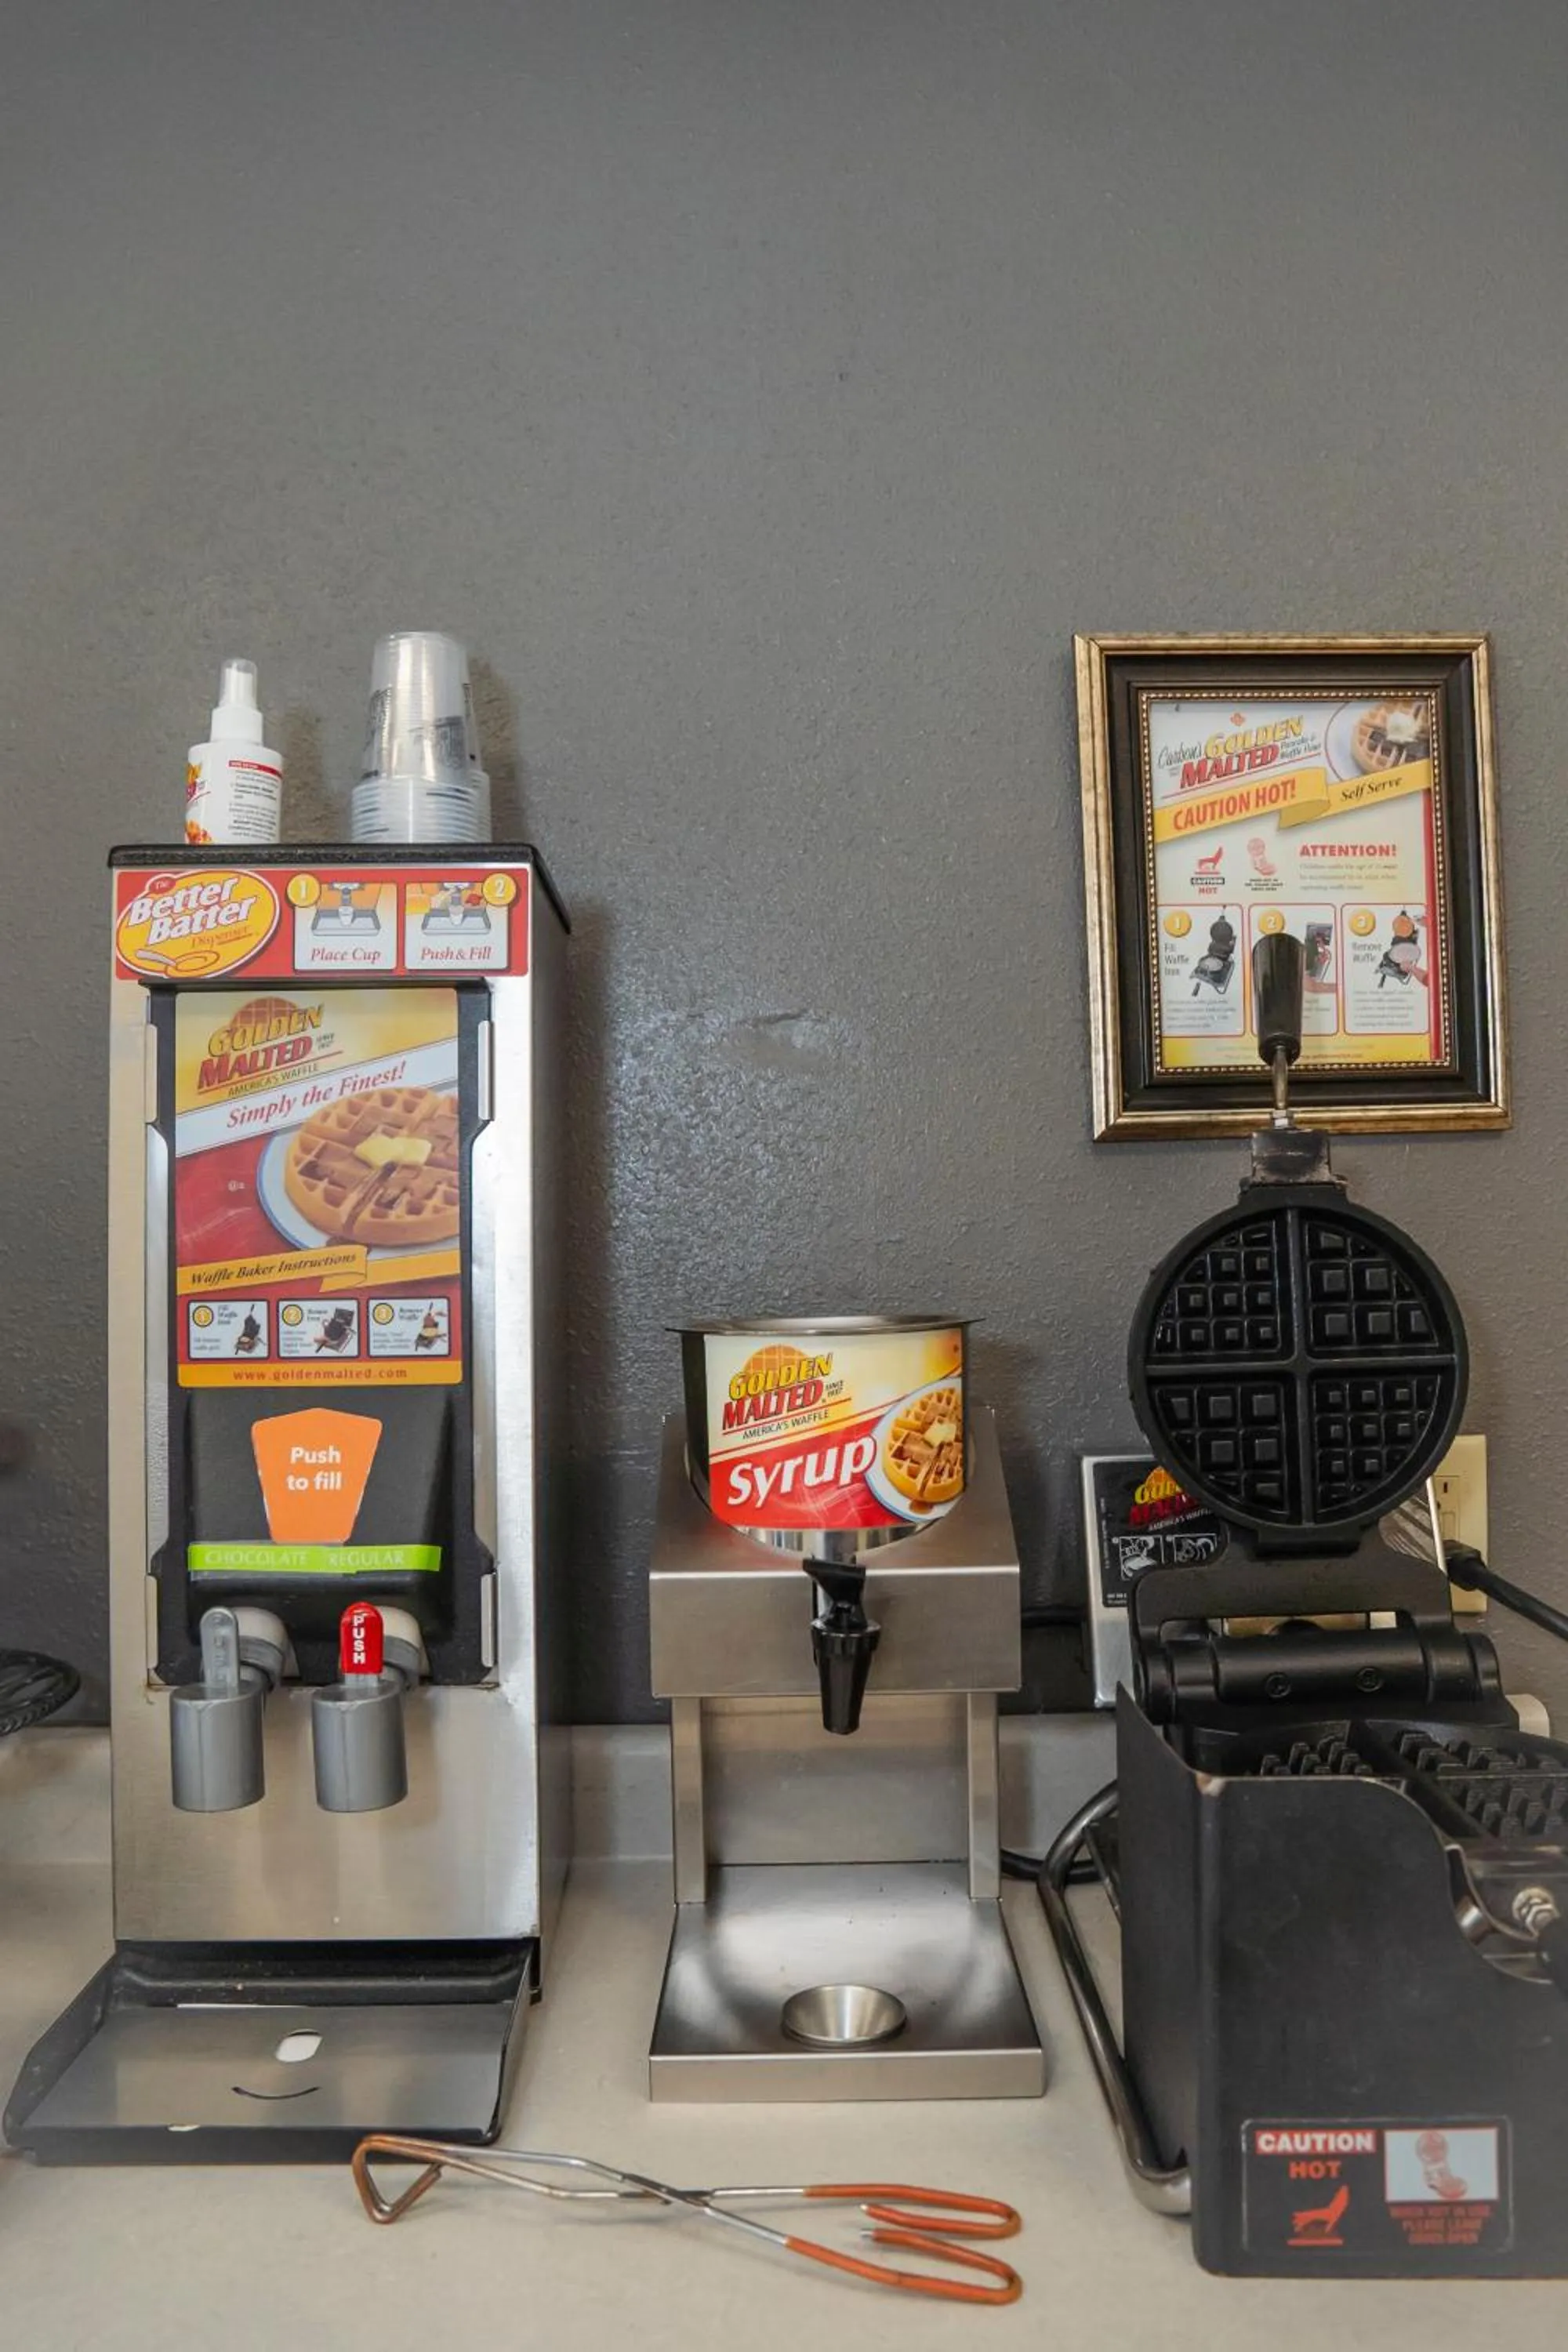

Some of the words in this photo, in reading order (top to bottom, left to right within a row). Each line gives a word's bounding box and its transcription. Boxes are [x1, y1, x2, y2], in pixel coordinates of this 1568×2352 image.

[1205, 715, 1304, 759] GOLDEN
[1180, 744, 1280, 788] MALTED
[1340, 784, 1365, 802] Self
[1366, 776, 1403, 795] Serve
[1173, 791, 1251, 831] CAUTION
[1254, 778, 1297, 805] HOT!
[1300, 844, 1397, 856] ATTENTION!
[126, 876, 240, 927] Better
[299, 879, 307, 901] 1
[495, 878, 505, 898] 2
[147, 896, 257, 946] Batter
[1266, 916, 1276, 928] 2
[1357, 916, 1367, 928] 3
[310, 947, 347, 961] Place
[352, 947, 382, 964] Cup
[421, 946, 455, 960] Push
[469, 946, 492, 960] Fill
[209, 1004, 325, 1057] GOLDEN
[198, 1036, 313, 1089] MALTED
[227, 1094, 297, 1128] Simply
[302, 1086, 333, 1108] the
[339, 1060, 408, 1096] Finest!
[228, 1075, 279, 1097] AMERICA'S
[281, 1063, 319, 1081] WAFFLE
[191, 1265, 234, 1287] Waffle
[236, 1262, 274, 1279] Baker
[278, 1252, 358, 1273] Instructions
[233, 1367, 407, 1381] www.goldenmalted.com
[728, 1352, 833, 1400] GOLDEN
[722, 1379, 824, 1431] MALTED
[742, 1421, 789, 1439] AMERICA'S
[791, 1410, 829, 1427] WAFFLE
[290, 1446, 341, 1465] Push
[287, 1475, 309, 1491] to
[314, 1474, 342, 1490] fill
[726, 1433, 877, 1508] Syrup
[204, 1550, 309, 1566] CHOCOLATE
[328, 1549, 405, 1566] REGULAR
[352, 1613, 366, 1664] PUSH
[1258, 2132, 1372, 2152] CAUTION
[1289, 2161, 1342, 2179] HOT
